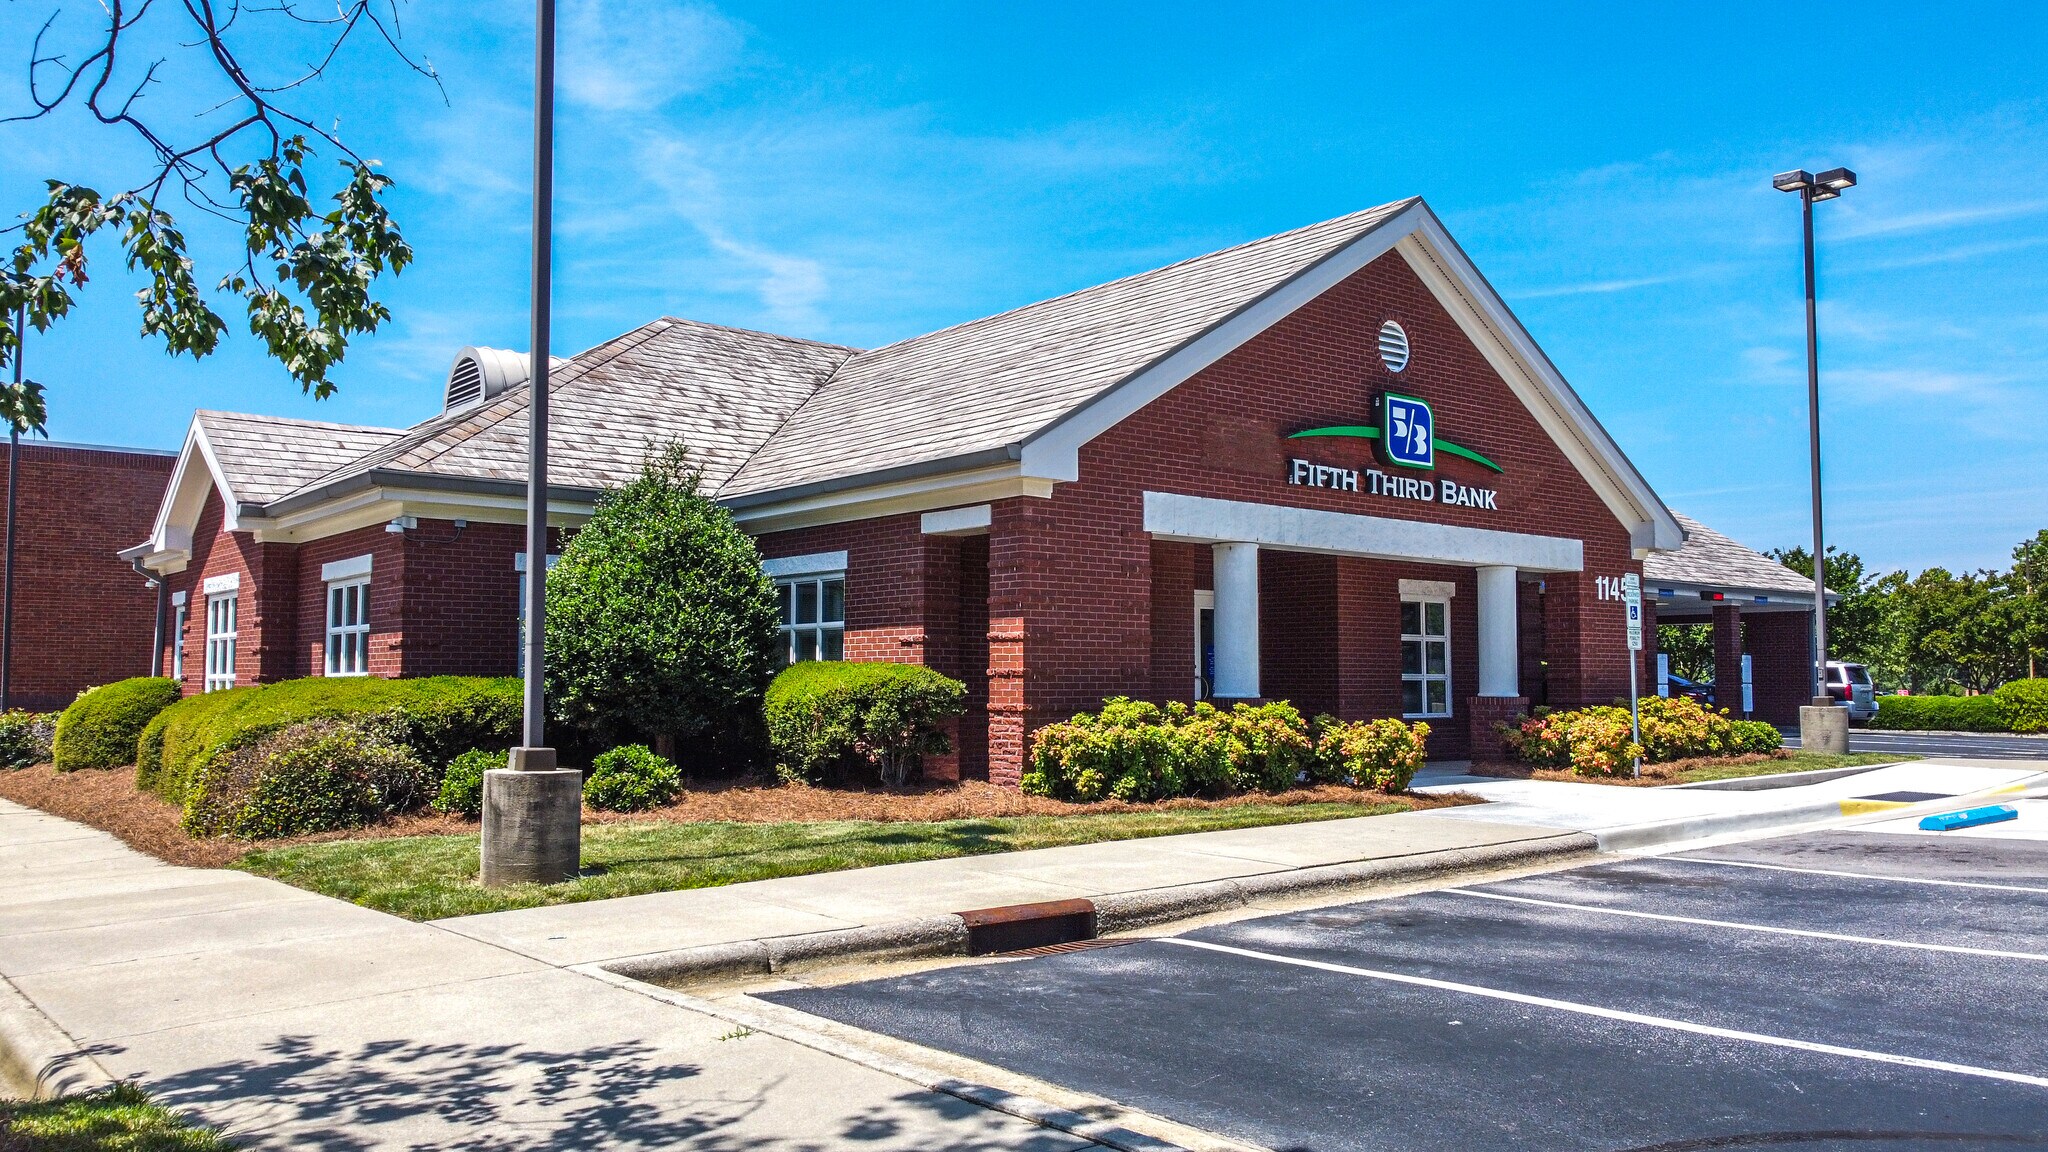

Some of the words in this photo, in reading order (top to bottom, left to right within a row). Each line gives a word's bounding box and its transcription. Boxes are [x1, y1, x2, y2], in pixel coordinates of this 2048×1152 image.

[1292, 458, 1358, 492] FIFTH
[1366, 468, 1434, 501] THIRD
[1440, 479, 1498, 510] BANK
[1595, 575, 1627, 602] 1145
